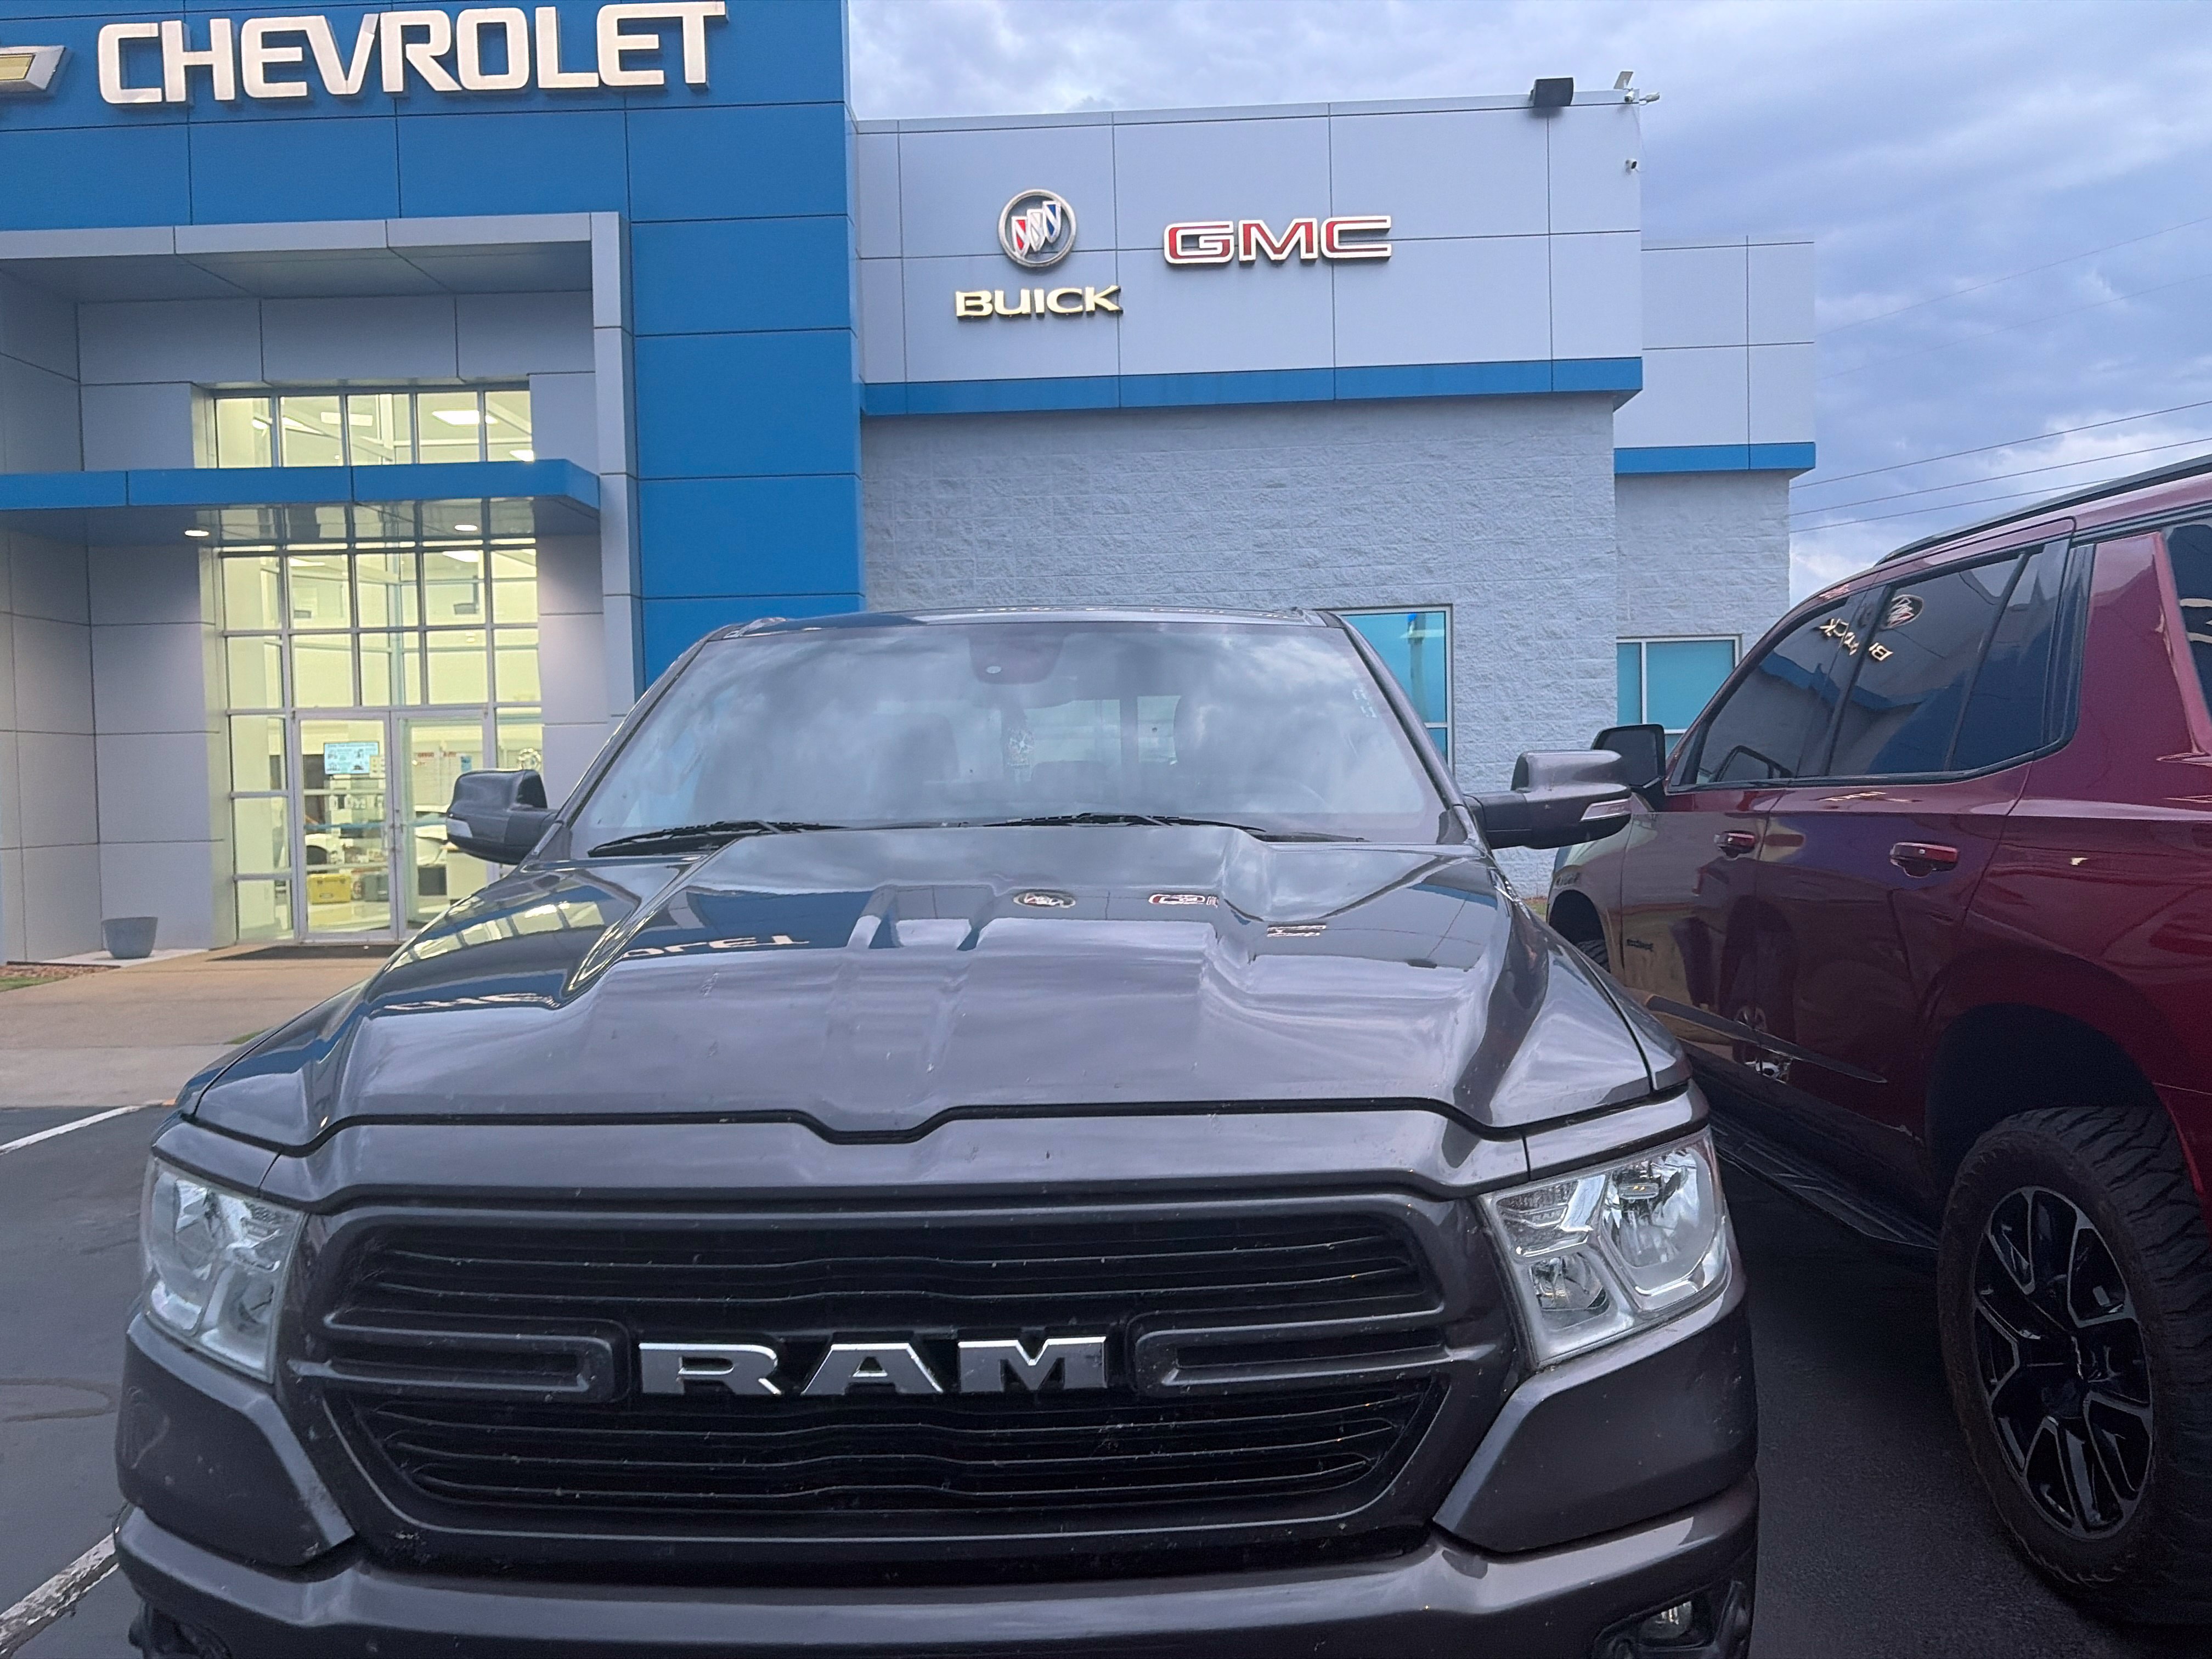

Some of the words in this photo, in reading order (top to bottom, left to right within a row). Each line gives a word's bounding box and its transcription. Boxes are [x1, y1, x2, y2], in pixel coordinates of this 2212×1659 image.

[98, 1, 726, 104] CHEVROLET
[1164, 215, 1391, 265] GMC
[956, 285, 1122, 319] BUICK
[638, 1336, 1107, 1396] RAM
